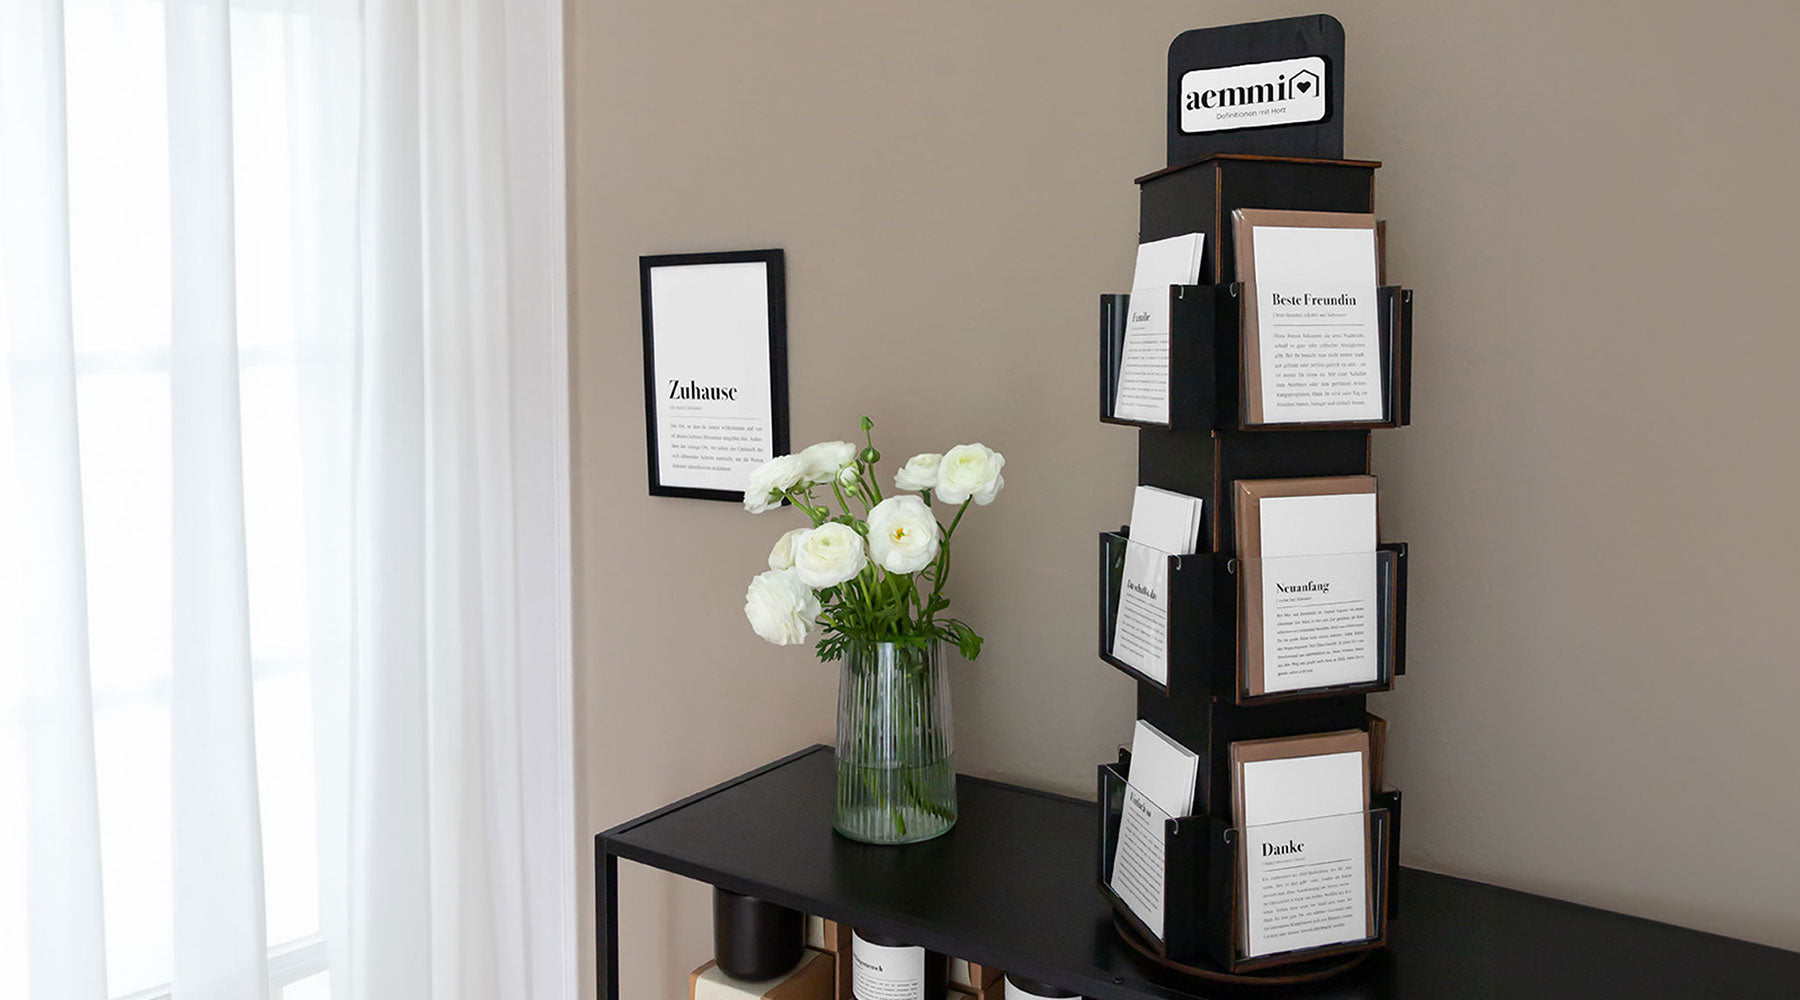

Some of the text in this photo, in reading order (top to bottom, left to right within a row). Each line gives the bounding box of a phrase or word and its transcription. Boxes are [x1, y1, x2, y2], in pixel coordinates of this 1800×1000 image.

[1186, 74, 1286, 111] aemmi
[1216, 109, 1258, 120] Definitionen
[1272, 293, 1357, 306] Beste Freundin
[669, 379, 738, 401] Zuhause
[1276, 581, 1330, 594] Neuanfang
[1262, 840, 1305, 857] Danke
